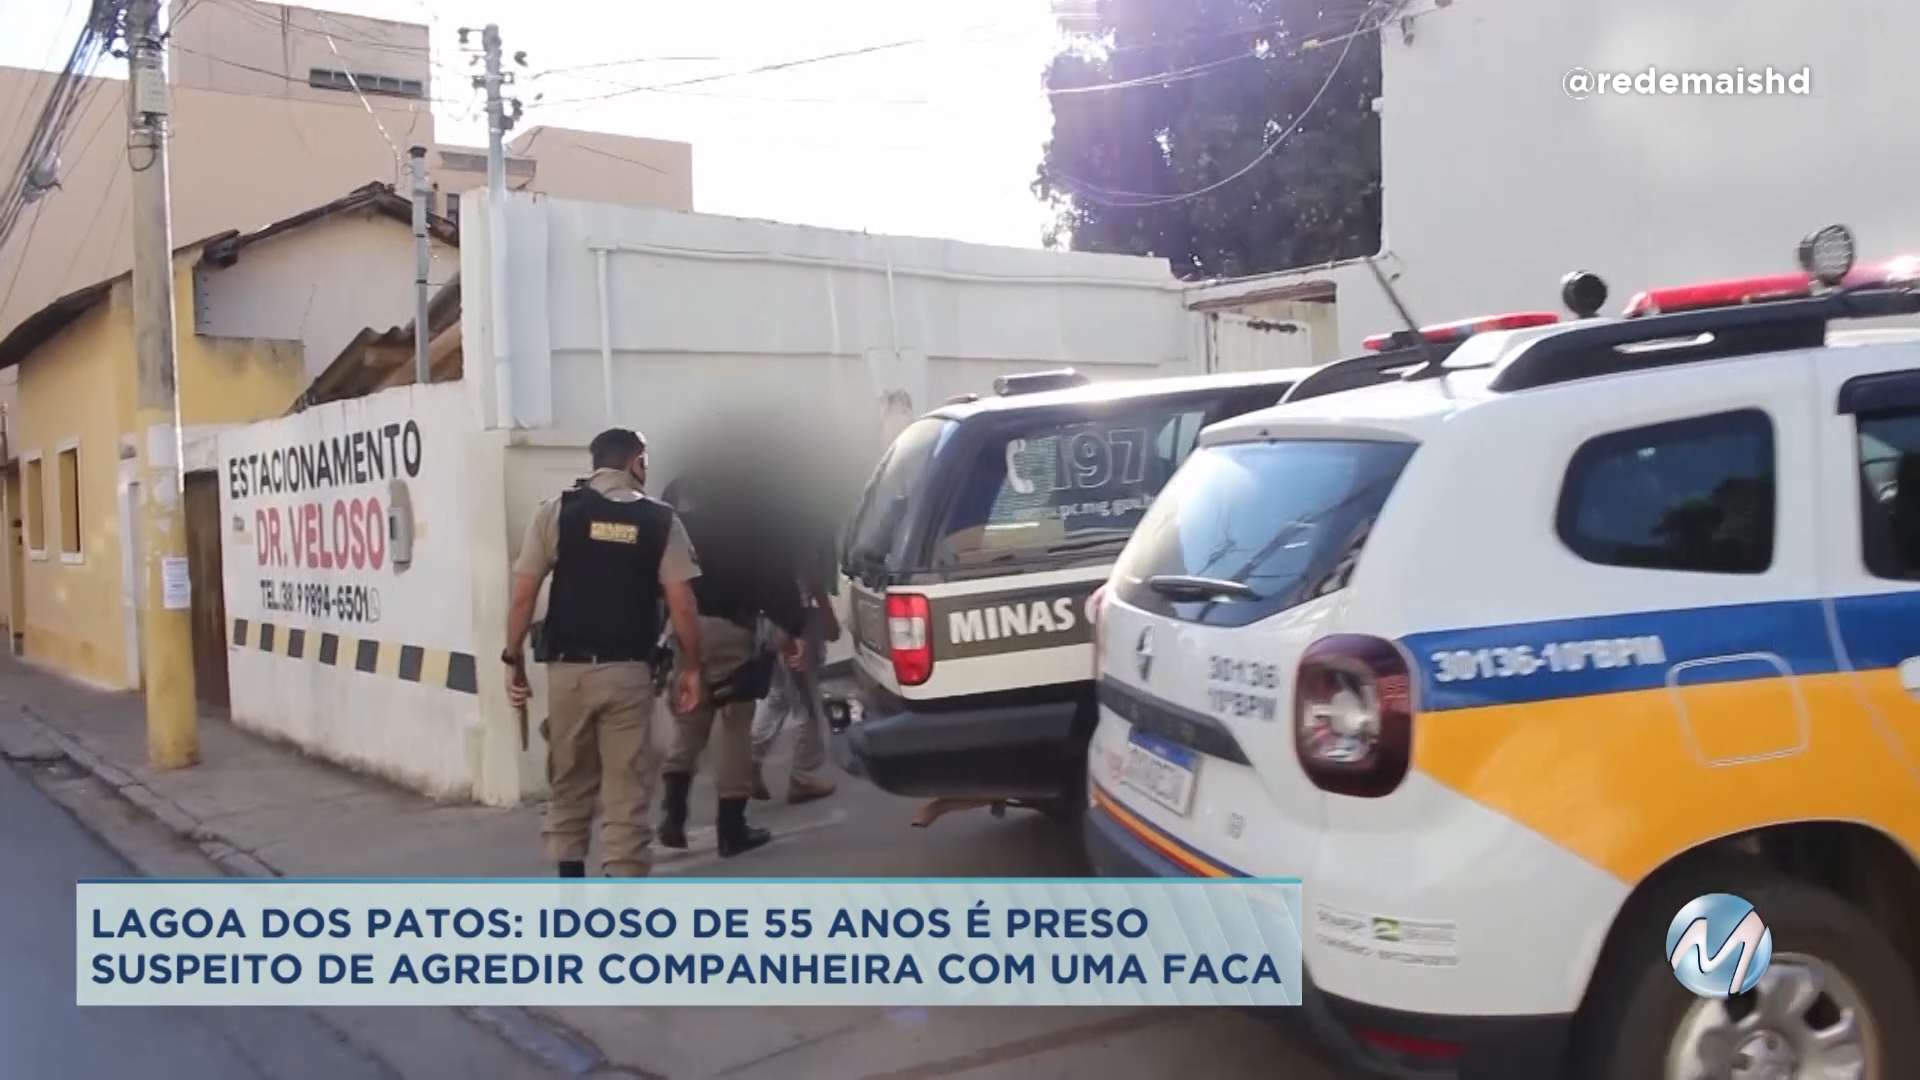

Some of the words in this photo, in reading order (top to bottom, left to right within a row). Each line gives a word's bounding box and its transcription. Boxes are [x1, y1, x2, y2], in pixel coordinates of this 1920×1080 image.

[229, 419, 422, 499] ESTACIONAMENTO
[1054, 428, 1147, 491] 197
[255, 507, 288, 567] DR.
[289, 497, 385, 570] VELOSO
[948, 597, 1076, 645] MINAS
[1207, 655, 1281, 690] 30136
